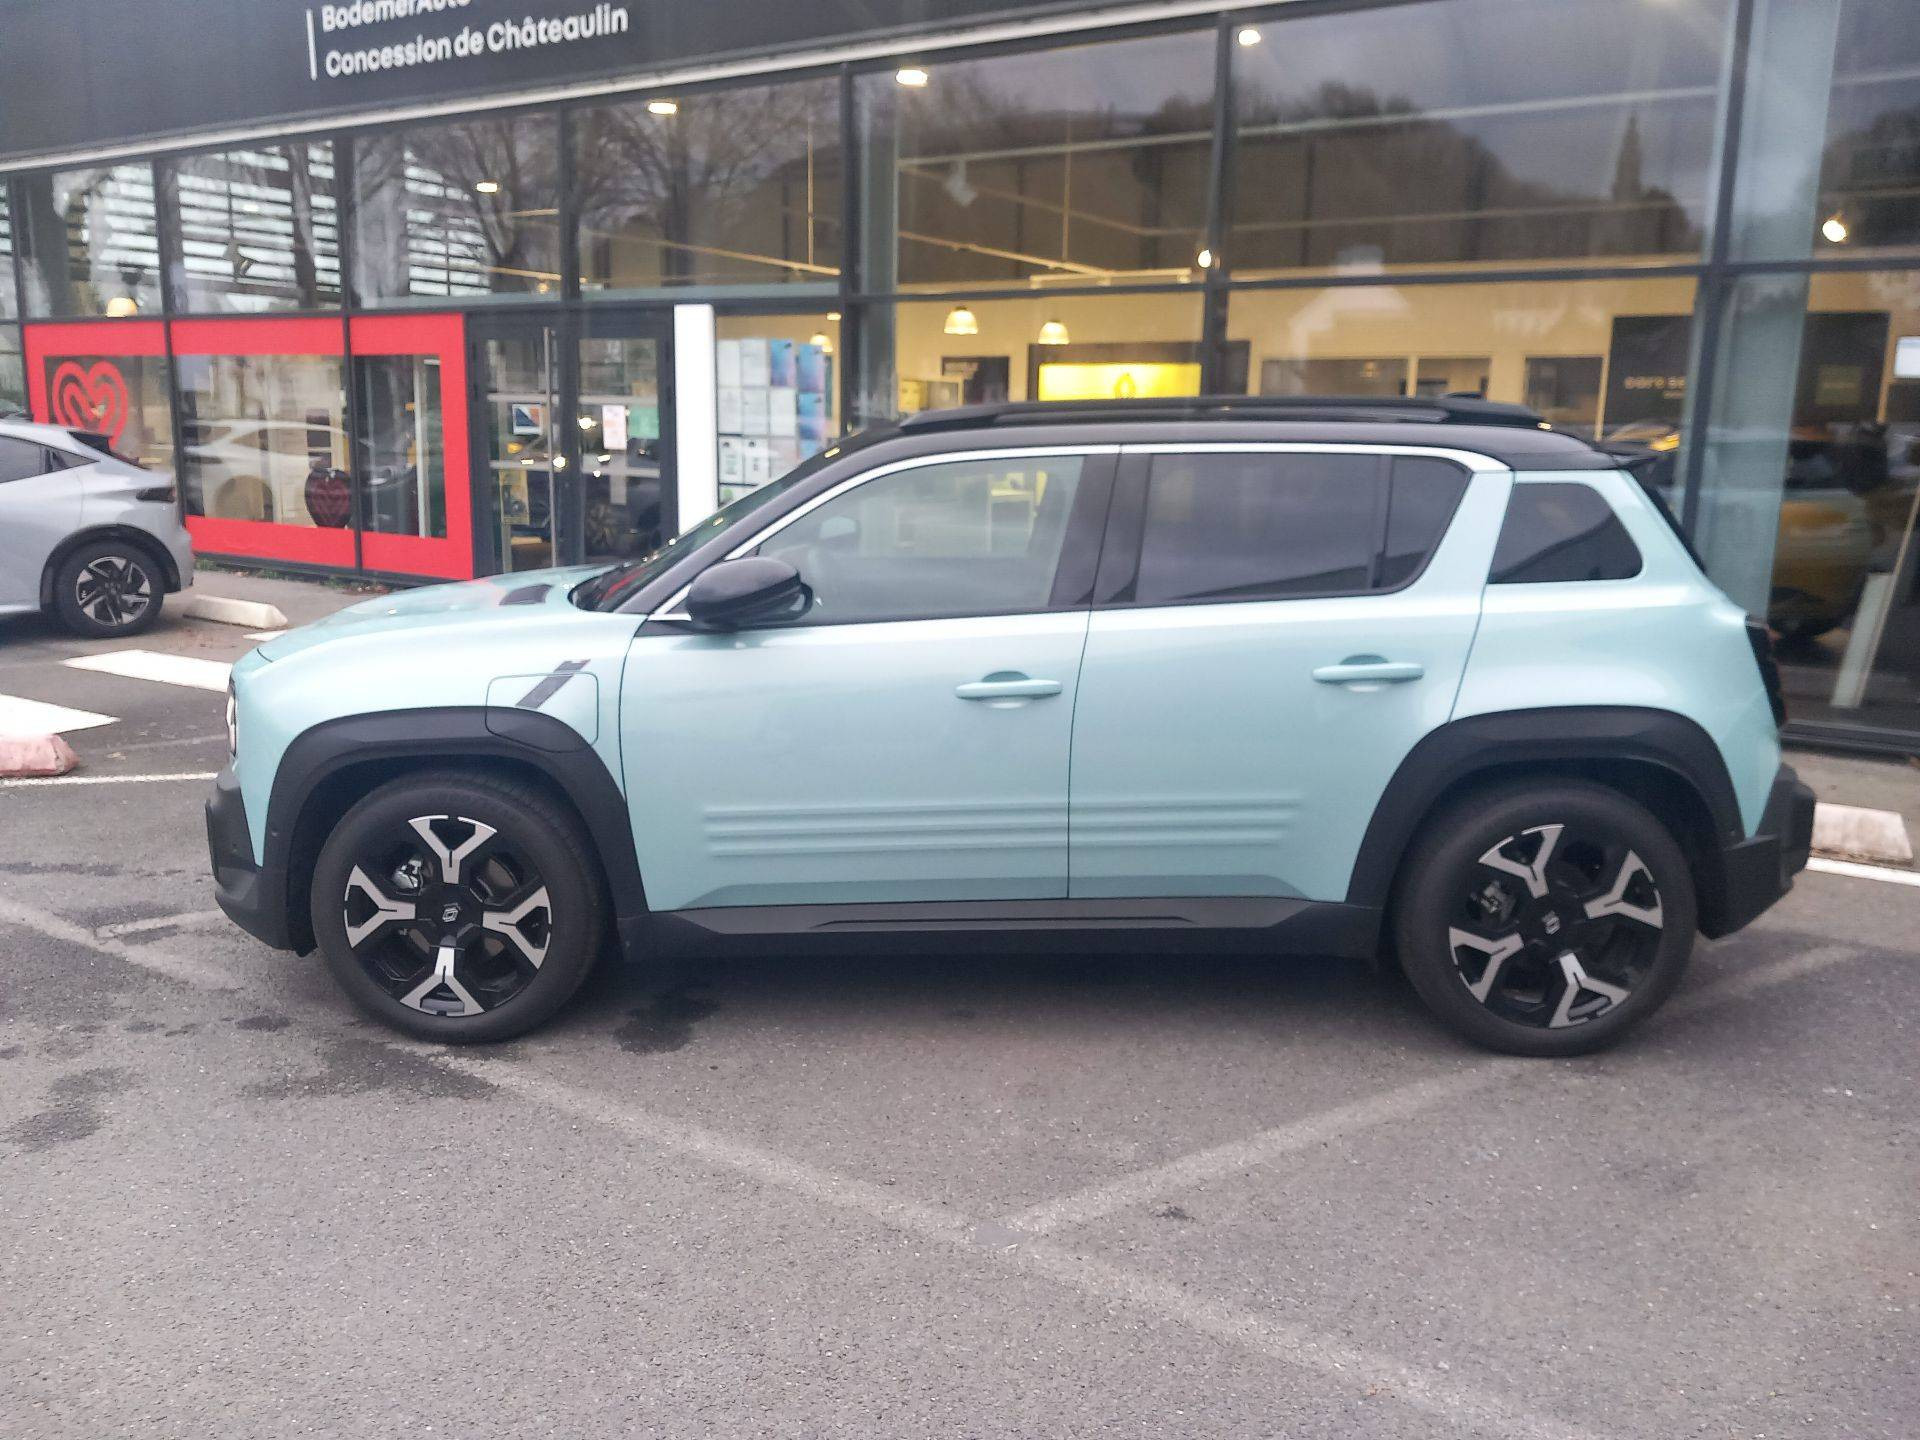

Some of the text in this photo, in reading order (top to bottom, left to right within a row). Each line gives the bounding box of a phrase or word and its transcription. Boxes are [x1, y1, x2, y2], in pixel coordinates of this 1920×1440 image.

[325, 3, 629, 78] Concession de Châteaulin
